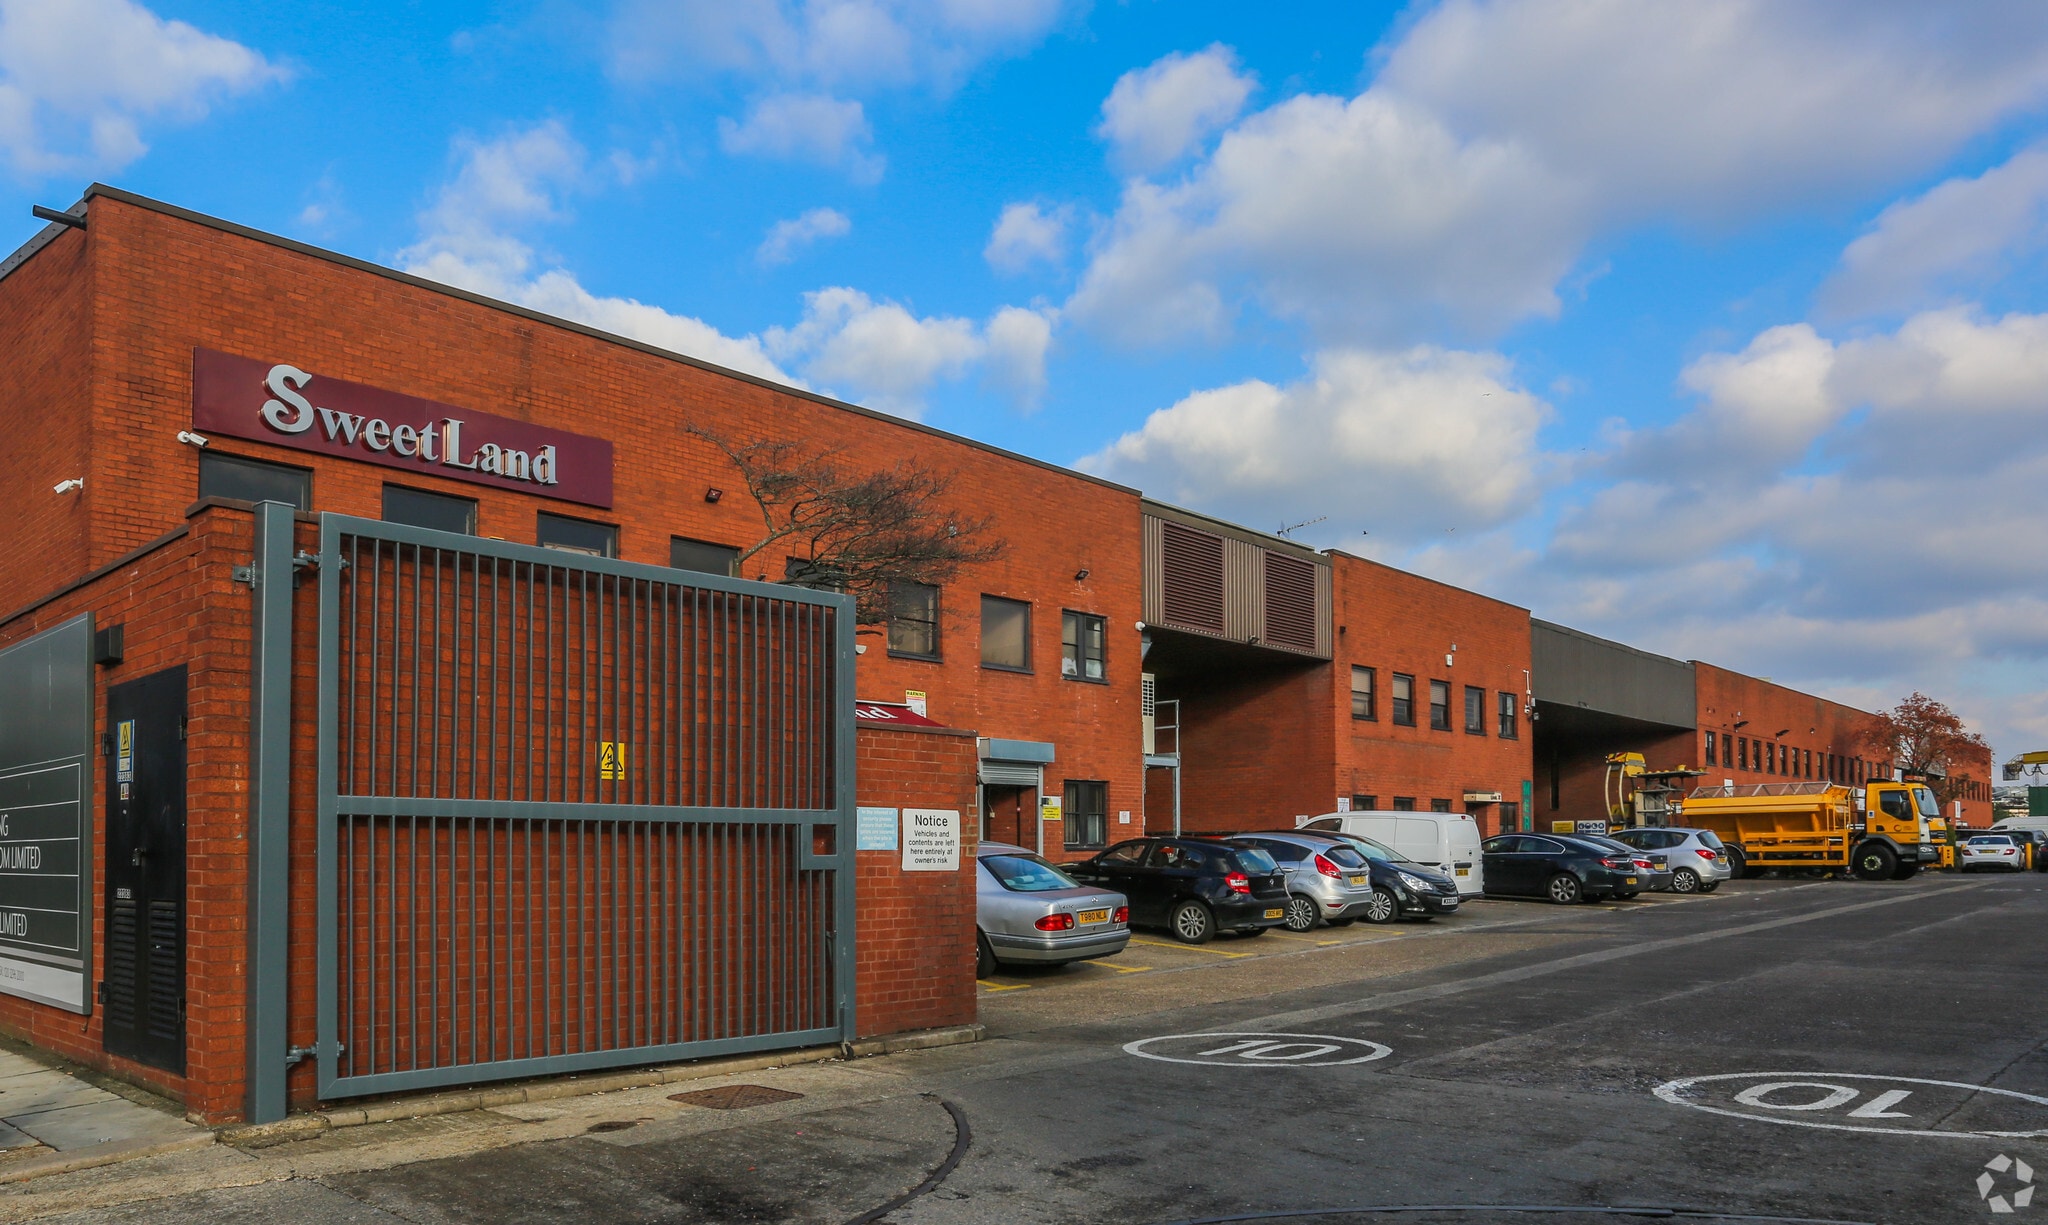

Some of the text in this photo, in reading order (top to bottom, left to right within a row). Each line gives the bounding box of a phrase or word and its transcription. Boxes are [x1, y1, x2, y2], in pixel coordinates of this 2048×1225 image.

[259, 364, 558, 485] SweetLand
[915, 814, 948, 827] Notice
[924, 848, 945, 856] entirely
[945, 839, 955, 847] left
[11, 846, 41, 869] LIMITED
[0, 911, 28, 937] LIMITED
[1197, 1040, 1342, 1060] 10
